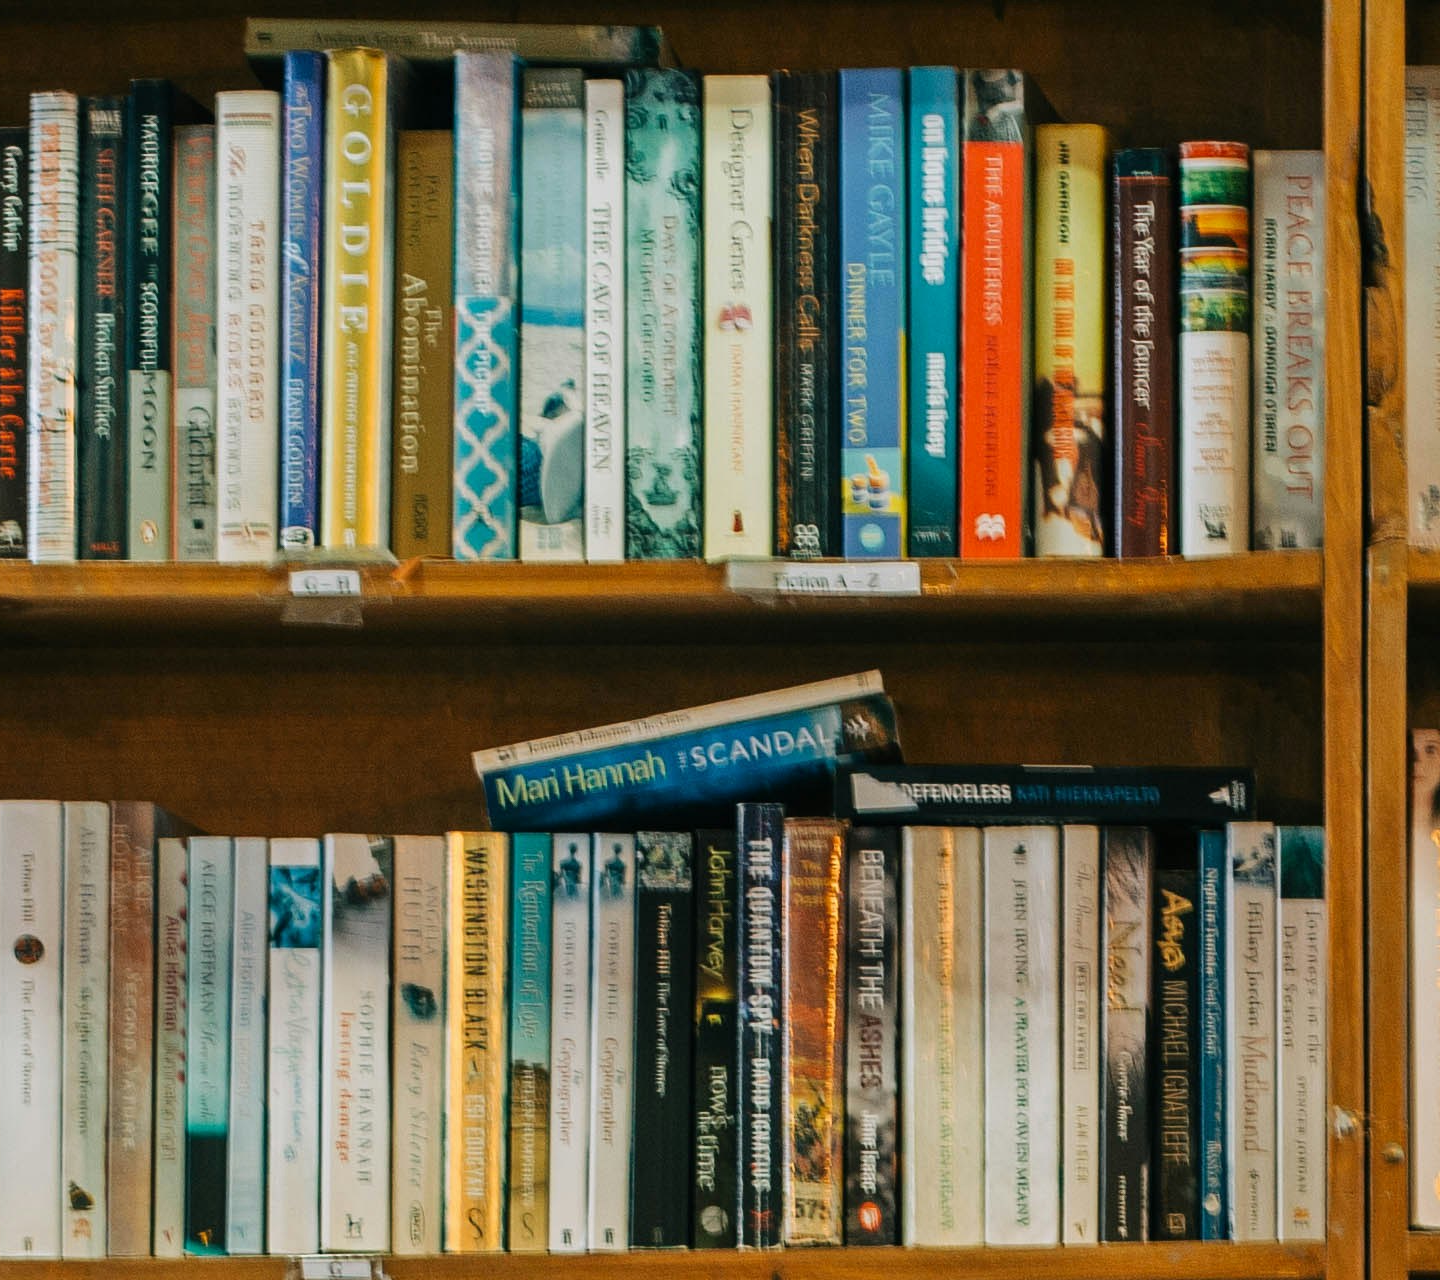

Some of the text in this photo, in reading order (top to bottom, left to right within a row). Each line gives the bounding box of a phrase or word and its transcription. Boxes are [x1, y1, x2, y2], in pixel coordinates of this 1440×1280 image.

[1132, 201, 1154, 236] The
[1132, 238, 1154, 274] Year
[1134, 280, 1156, 298] of
[1134, 305, 1156, 338] the
[689, 723, 833, 768] SCANDAL
[495, 752, 666, 807] Mari Hannah
[856, 849, 885, 1091] BENEATH THE ASHES
